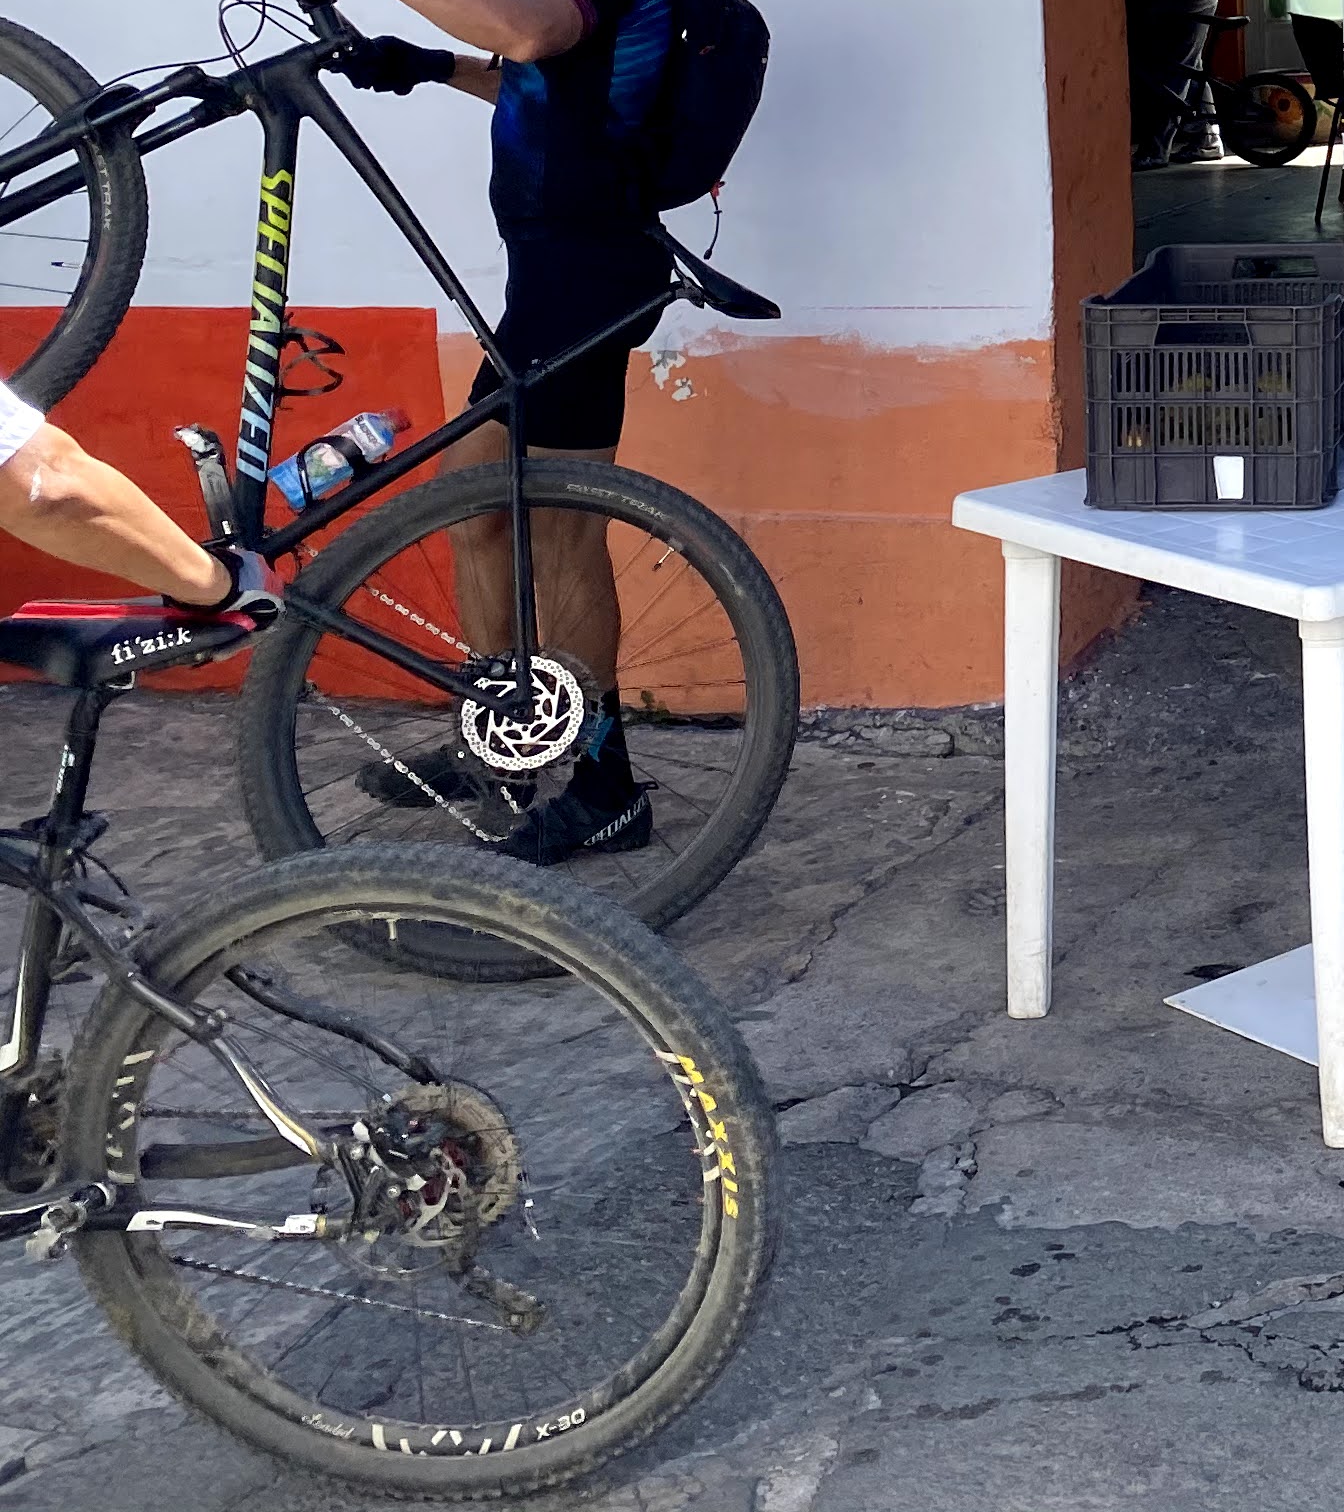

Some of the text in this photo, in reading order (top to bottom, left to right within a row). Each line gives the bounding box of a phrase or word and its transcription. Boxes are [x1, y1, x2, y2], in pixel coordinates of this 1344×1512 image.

[237, 169, 293, 483] SPECIALIZED
[677, 1054, 739, 1220] MAXXIS
[536, 1407, 586, 1440] X-30
